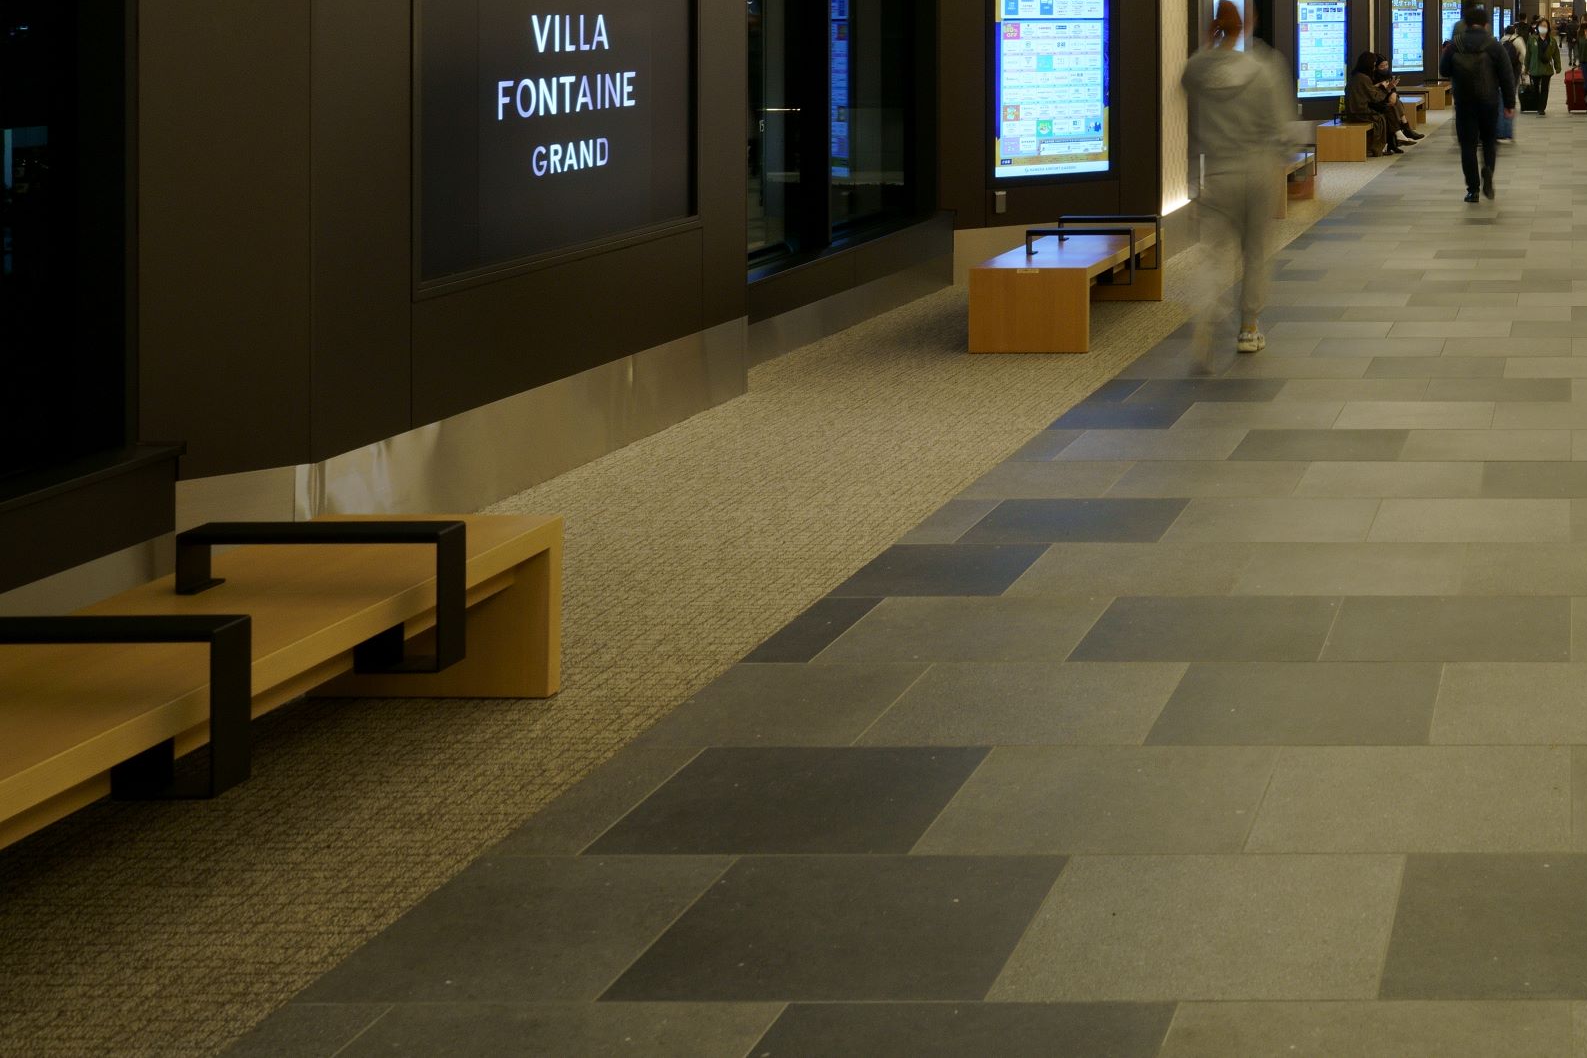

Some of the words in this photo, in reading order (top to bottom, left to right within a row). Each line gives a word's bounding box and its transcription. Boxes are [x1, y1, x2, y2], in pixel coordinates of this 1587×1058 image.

[531, 14, 609, 53] VILLA
[498, 71, 637, 120] FONTAINE
[532, 137, 609, 177] GRAND
